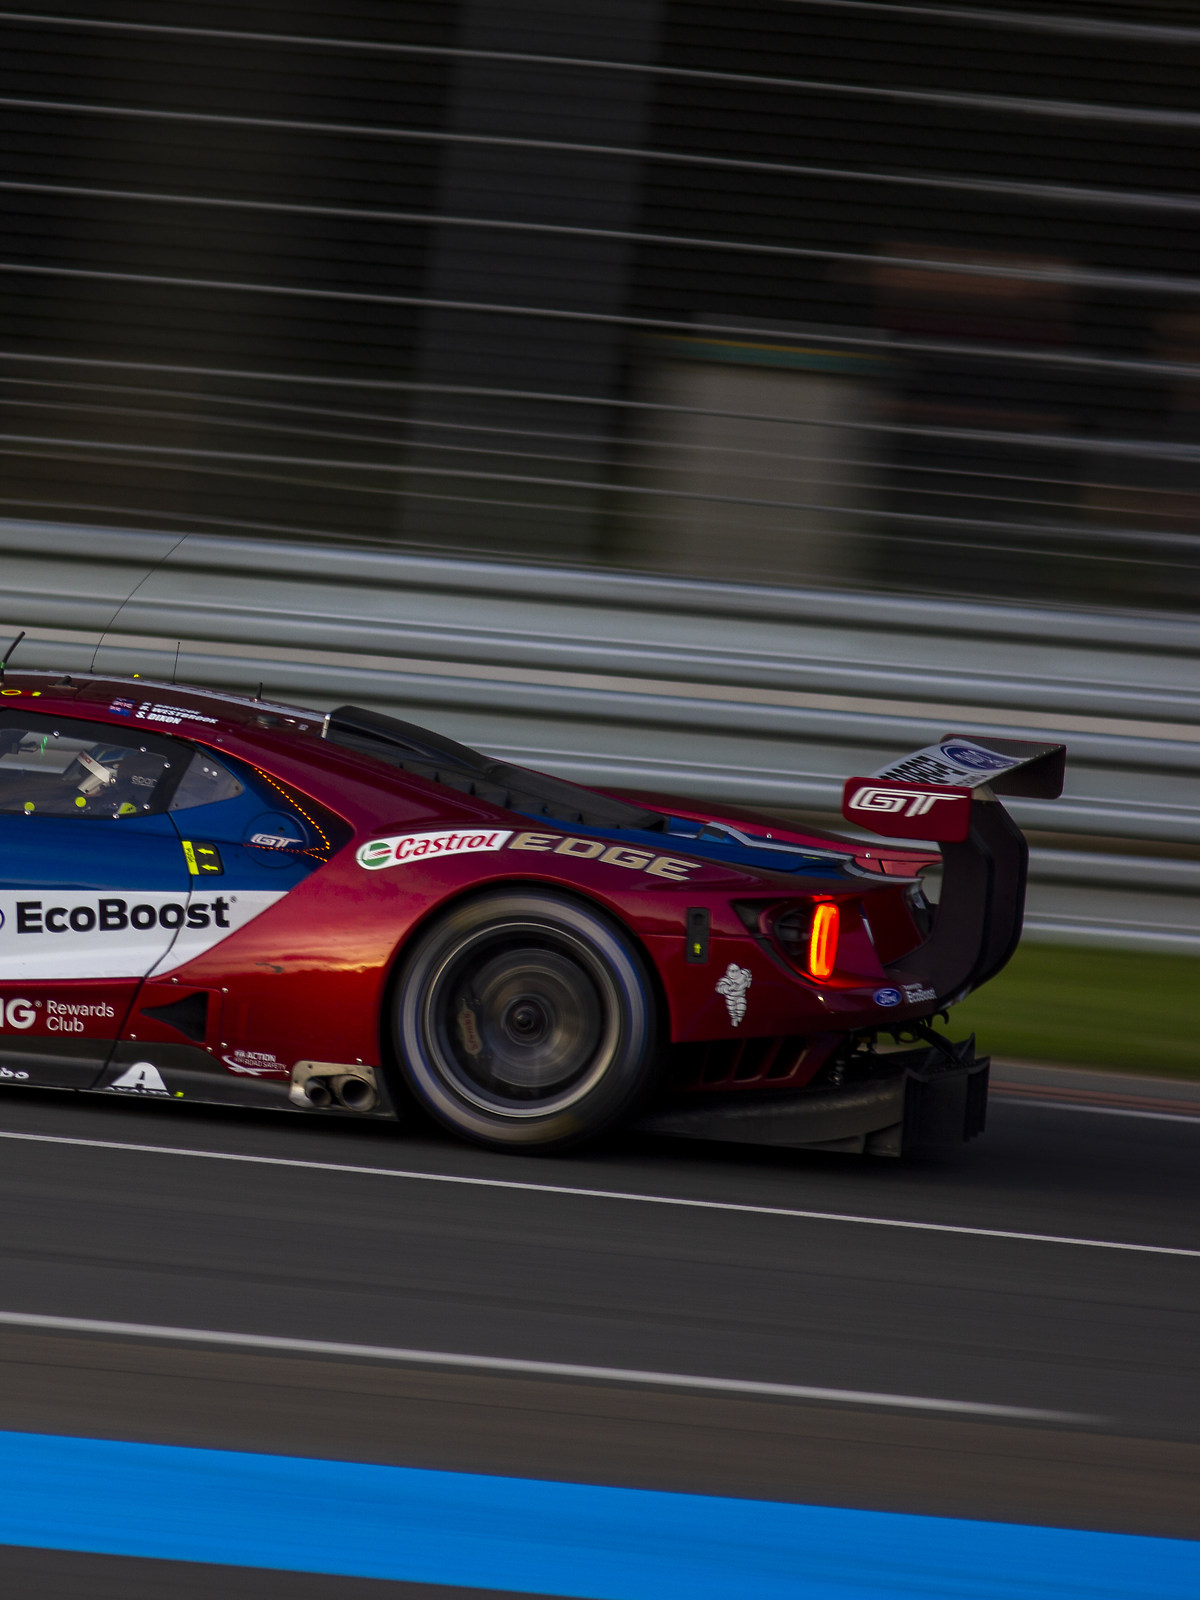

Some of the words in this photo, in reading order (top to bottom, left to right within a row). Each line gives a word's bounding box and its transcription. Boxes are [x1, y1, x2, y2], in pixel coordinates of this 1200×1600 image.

[135, 711, 146, 719] S.
[147, 713, 182, 724] DIXON
[849, 786, 968, 817] GT
[250, 833, 303, 848] GT
[395, 832, 500, 860] Castrol
[507, 832, 702, 881] EDGE
[46, 1000, 115, 1018] Rewards
[46, 1016, 85, 1032] Club
[247, 1051, 277, 1063] ACTION
